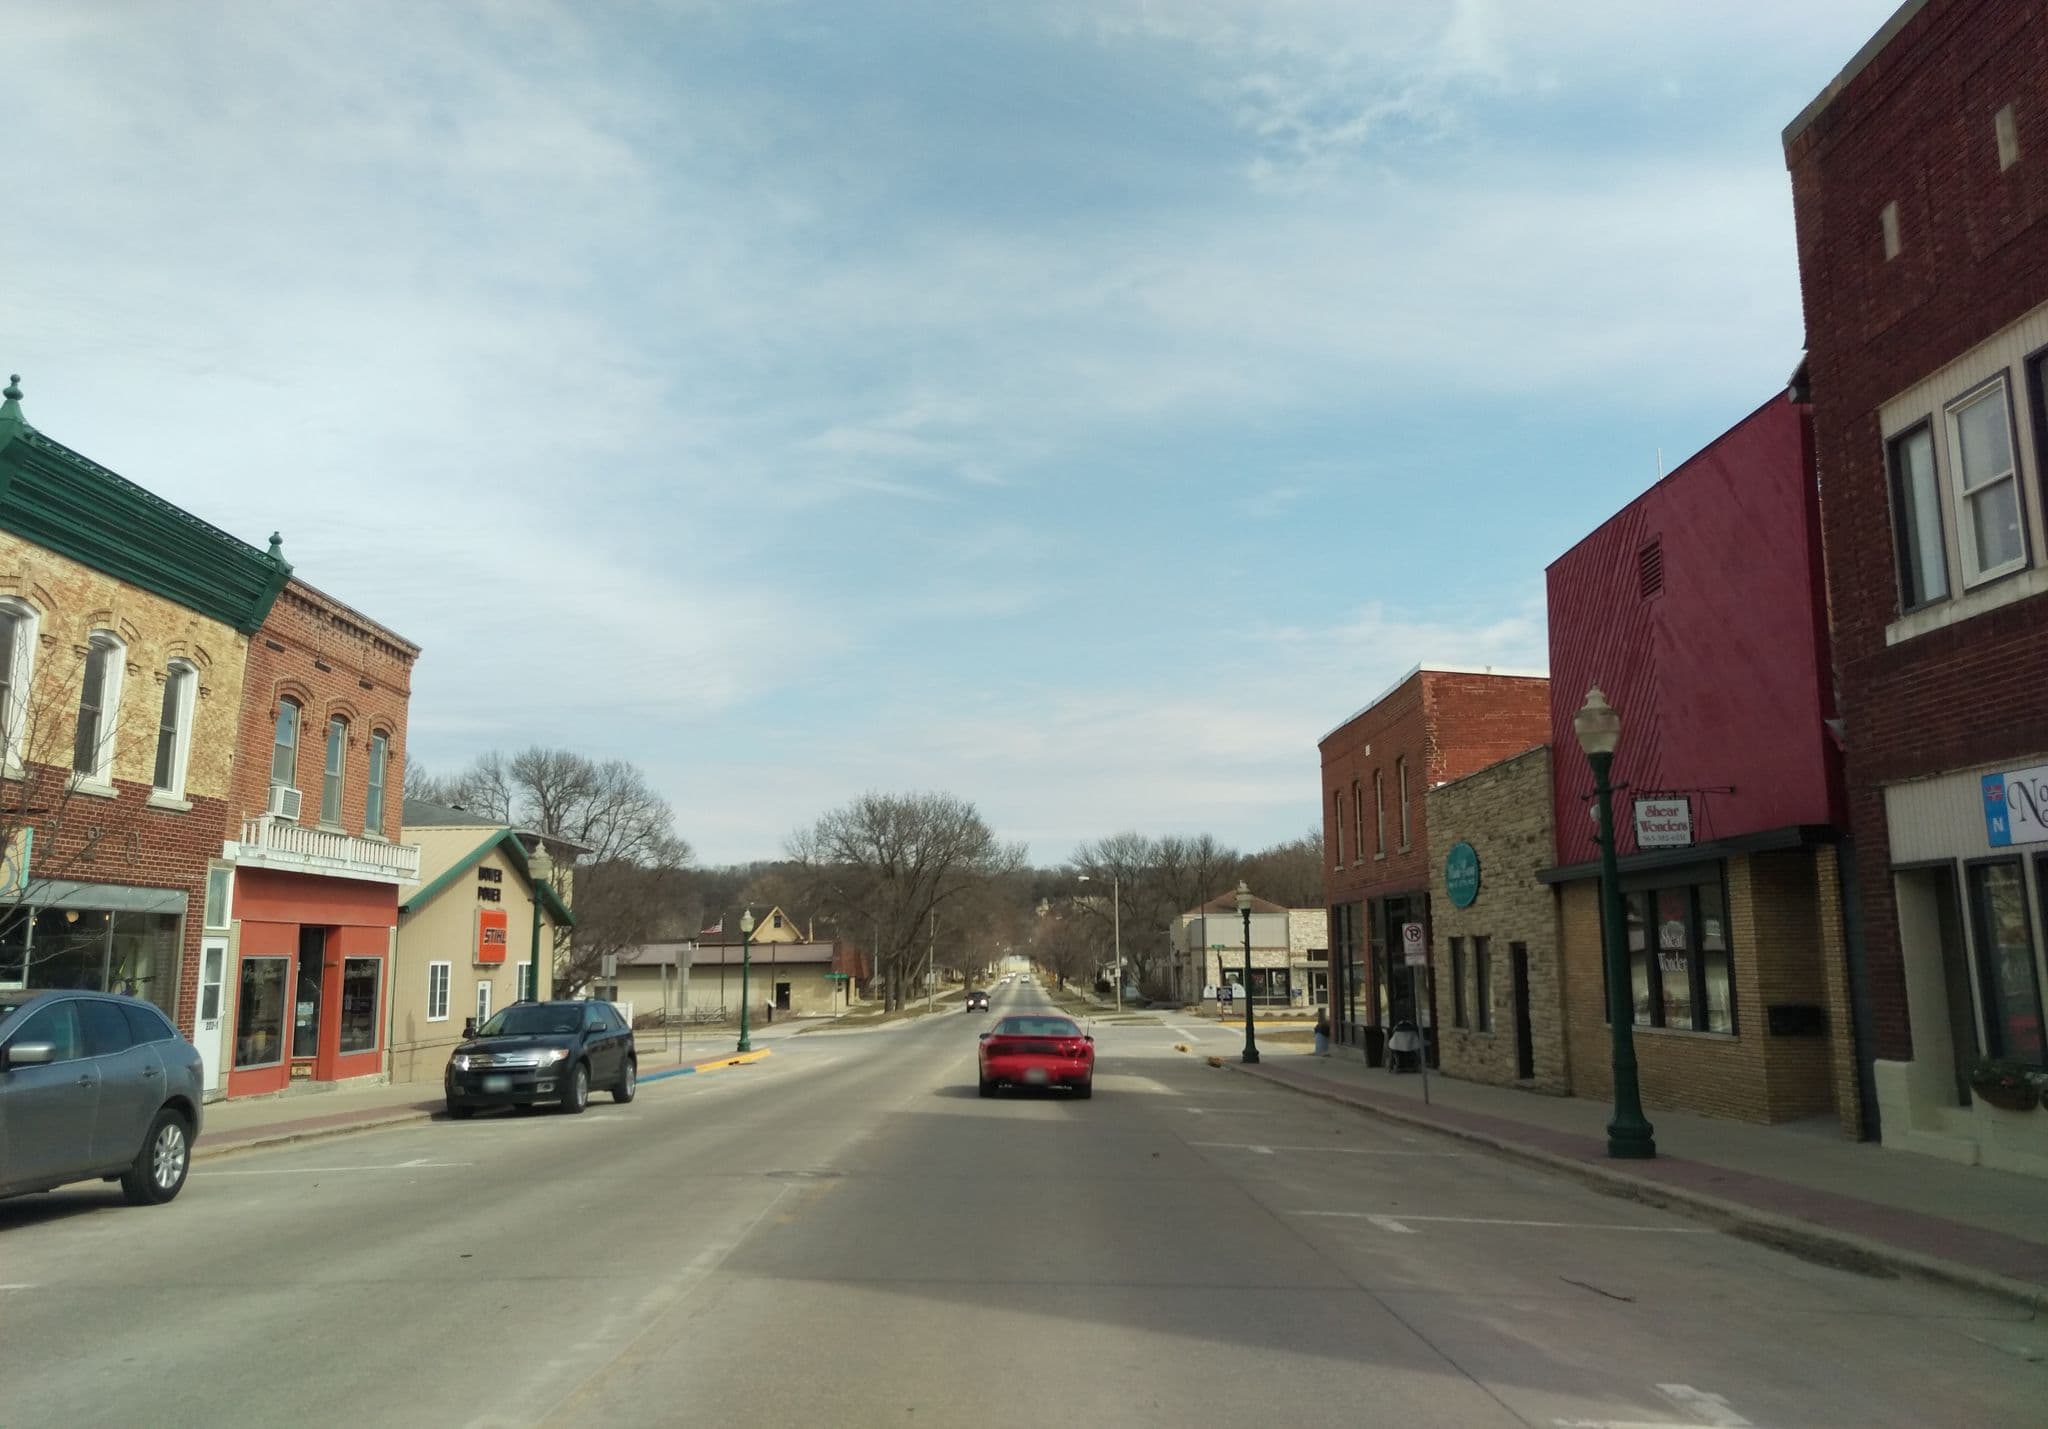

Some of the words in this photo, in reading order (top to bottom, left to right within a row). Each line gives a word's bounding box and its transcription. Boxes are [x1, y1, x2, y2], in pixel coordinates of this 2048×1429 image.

[1645, 804, 1679, 817] Shear
[1640, 819, 1689, 833] Wonders
[484, 928, 506, 944] STIHL
